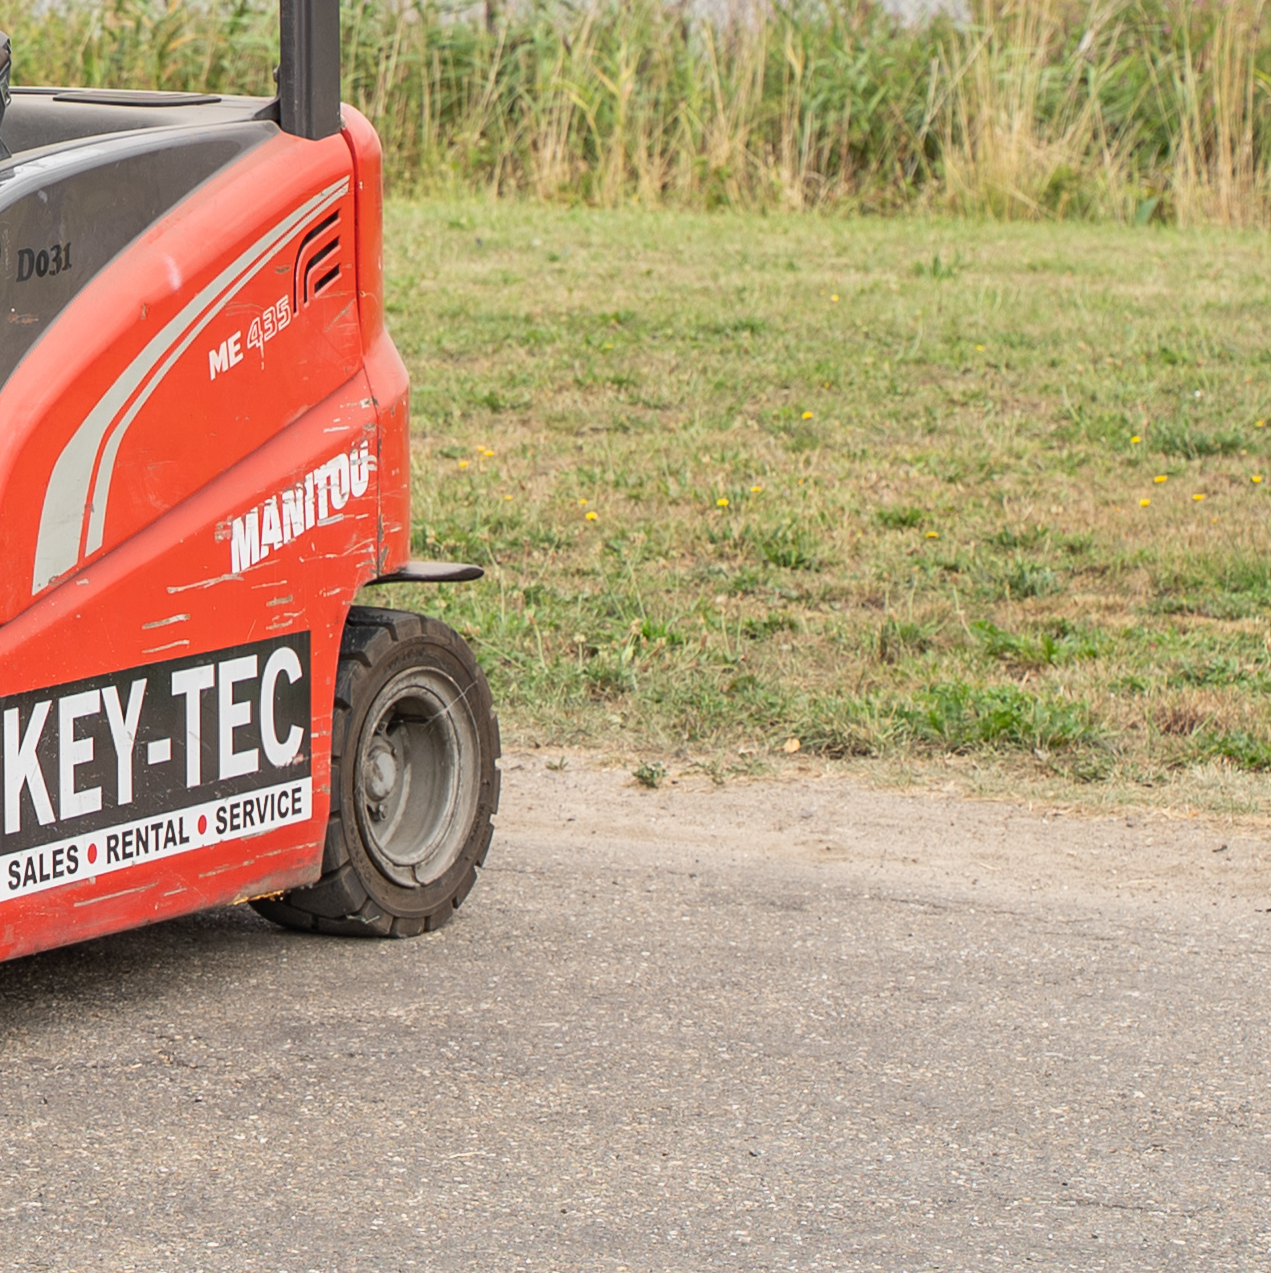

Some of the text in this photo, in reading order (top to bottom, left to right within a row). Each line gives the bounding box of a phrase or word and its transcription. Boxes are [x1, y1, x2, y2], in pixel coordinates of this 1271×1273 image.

[209, 294, 292, 381] ME 435
[231, 439, 371, 575] MANITOU
[3, 646, 305, 835] KEY-TEC
[7, 786, 303, 891] SALES RENTAL SERVICE
